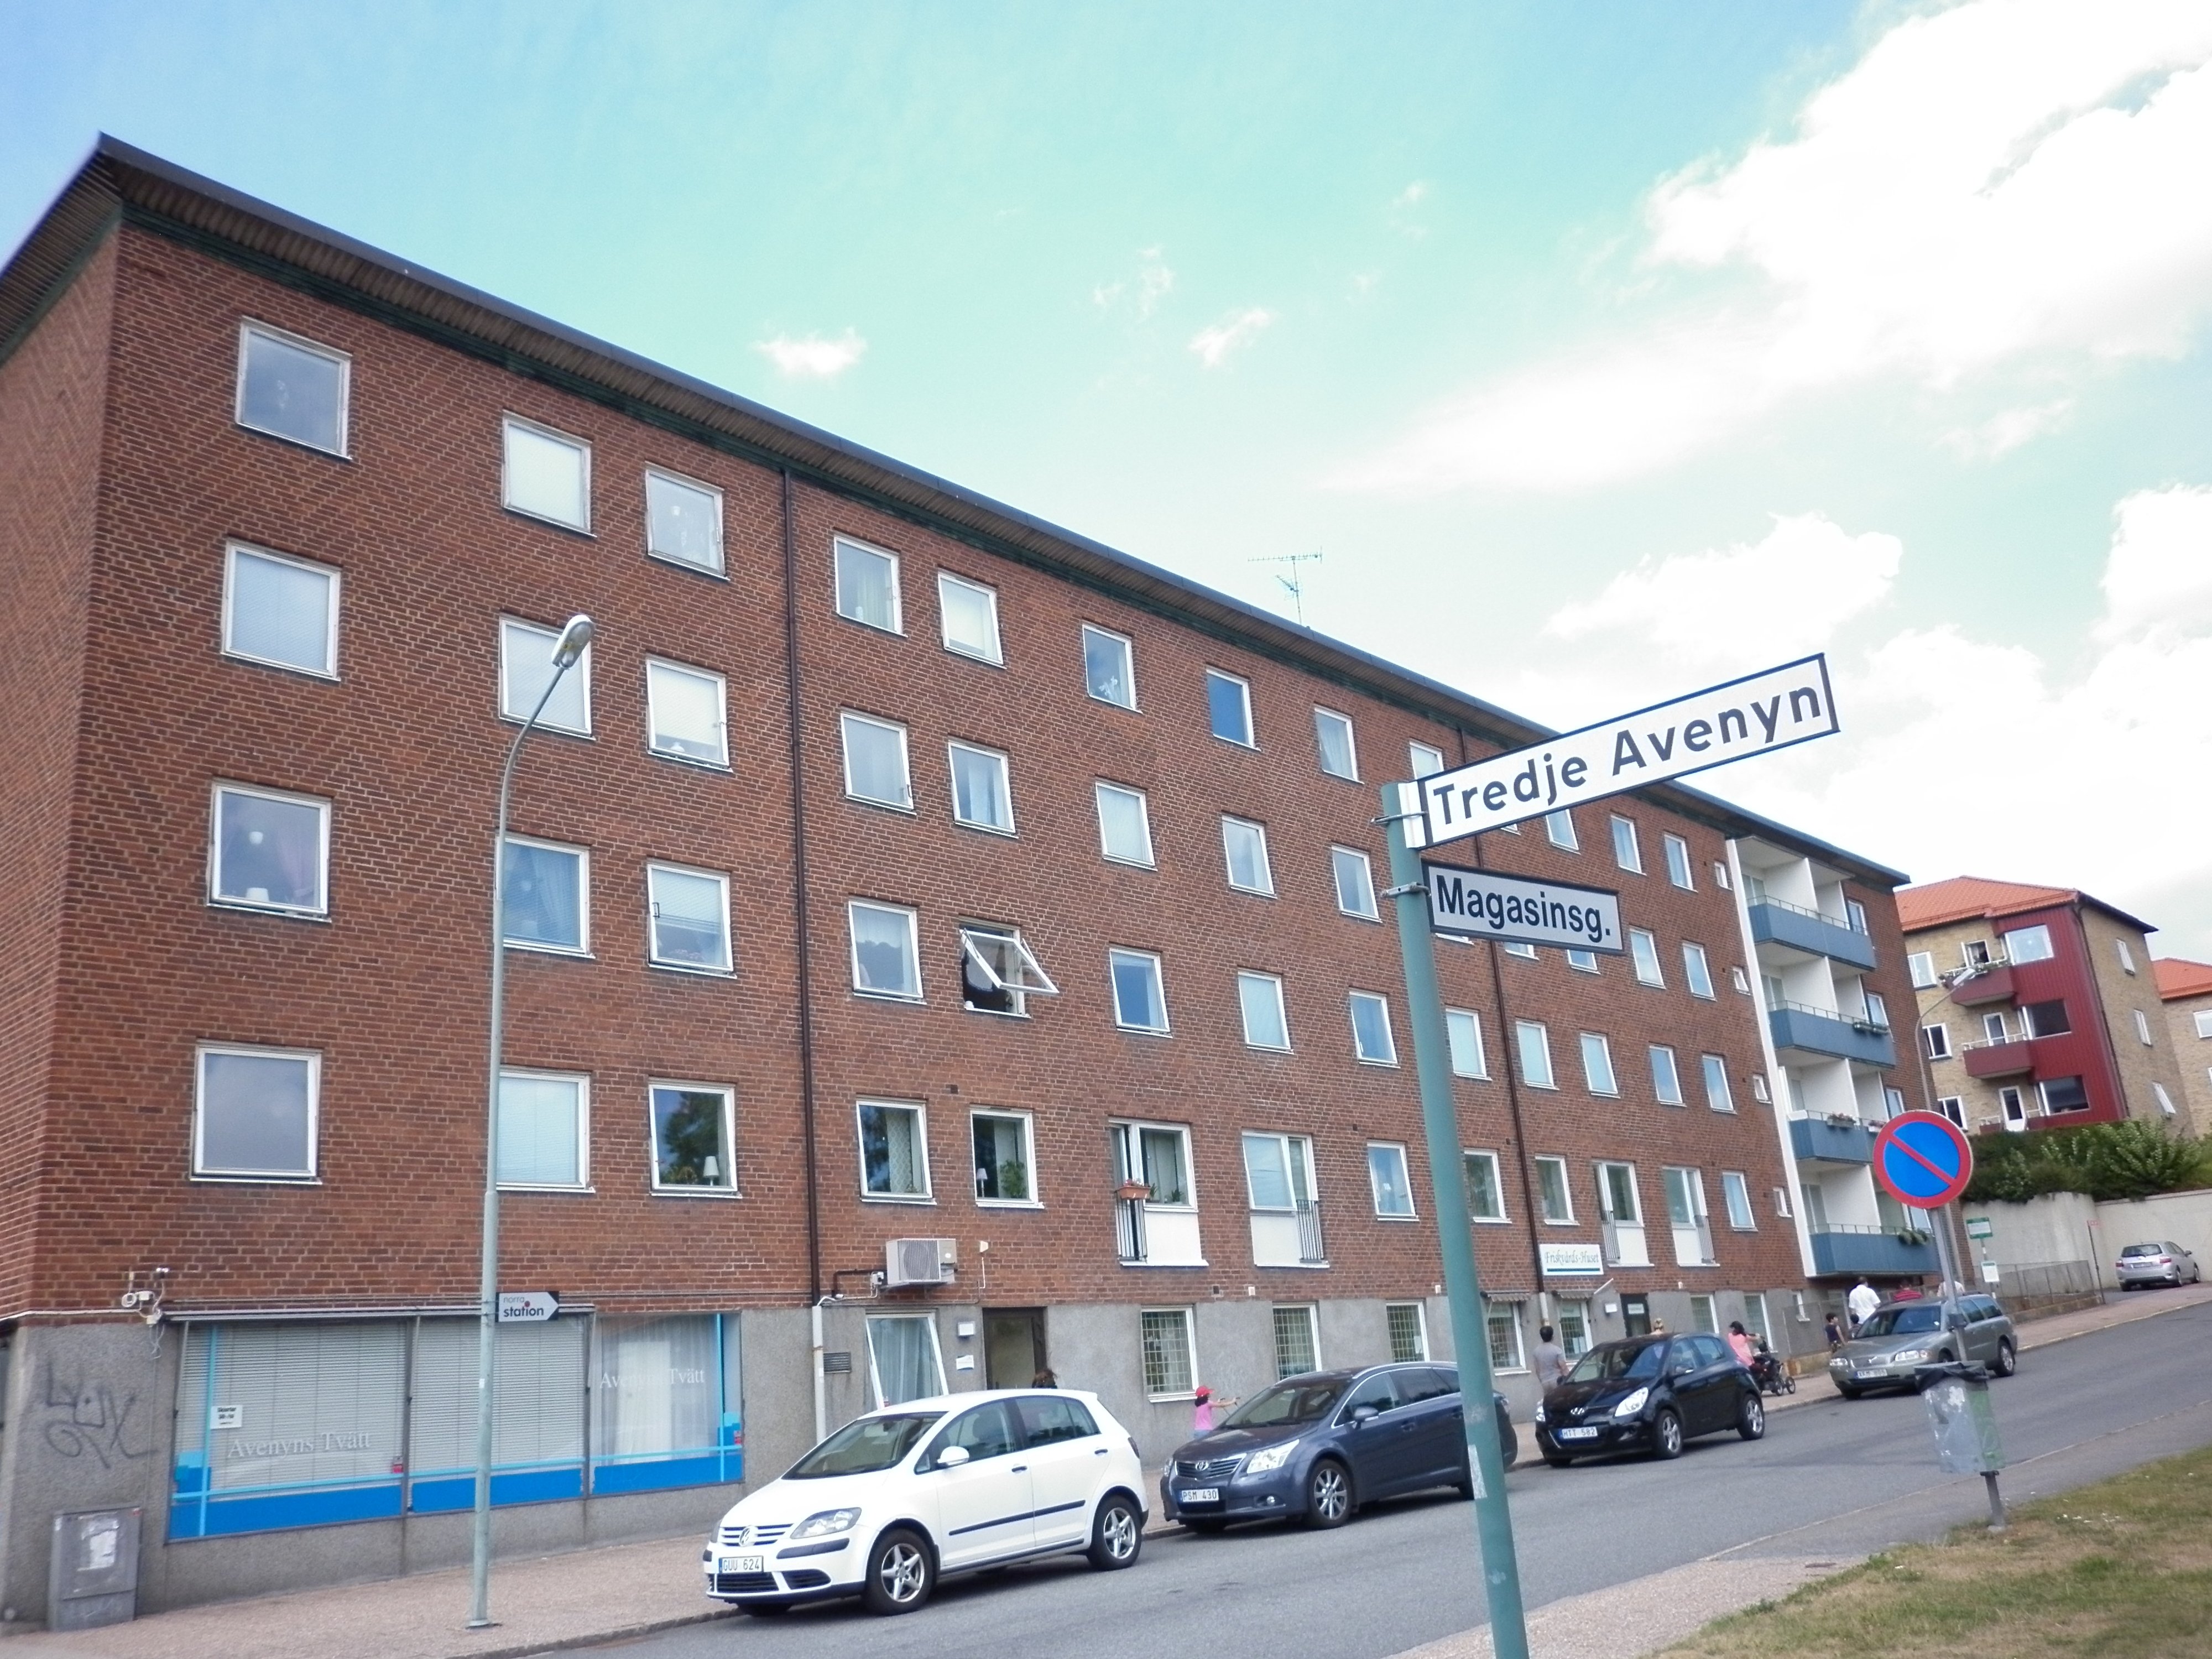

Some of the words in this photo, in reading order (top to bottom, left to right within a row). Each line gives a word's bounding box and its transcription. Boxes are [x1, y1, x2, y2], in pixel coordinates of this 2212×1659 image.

[1433, 753, 1588, 824] Tredje
[1613, 687, 1820, 776] Avenyn
[1436, 875, 1610, 943] Magasinsg.
[504, 1301, 544, 1317] station
[599, 1371, 667, 1391] Avenyn
[669, 1368, 705, 1384] Tvätt
[228, 1438, 314, 1458] Avenyns
[321, 1432, 369, 1450] Tvätt
[1183, 1491, 1197, 1500] PSM
[1202, 1490, 1217, 1500] 430
[723, 1559, 738, 1571] GUU
[743, 1558, 759, 1571] 624
